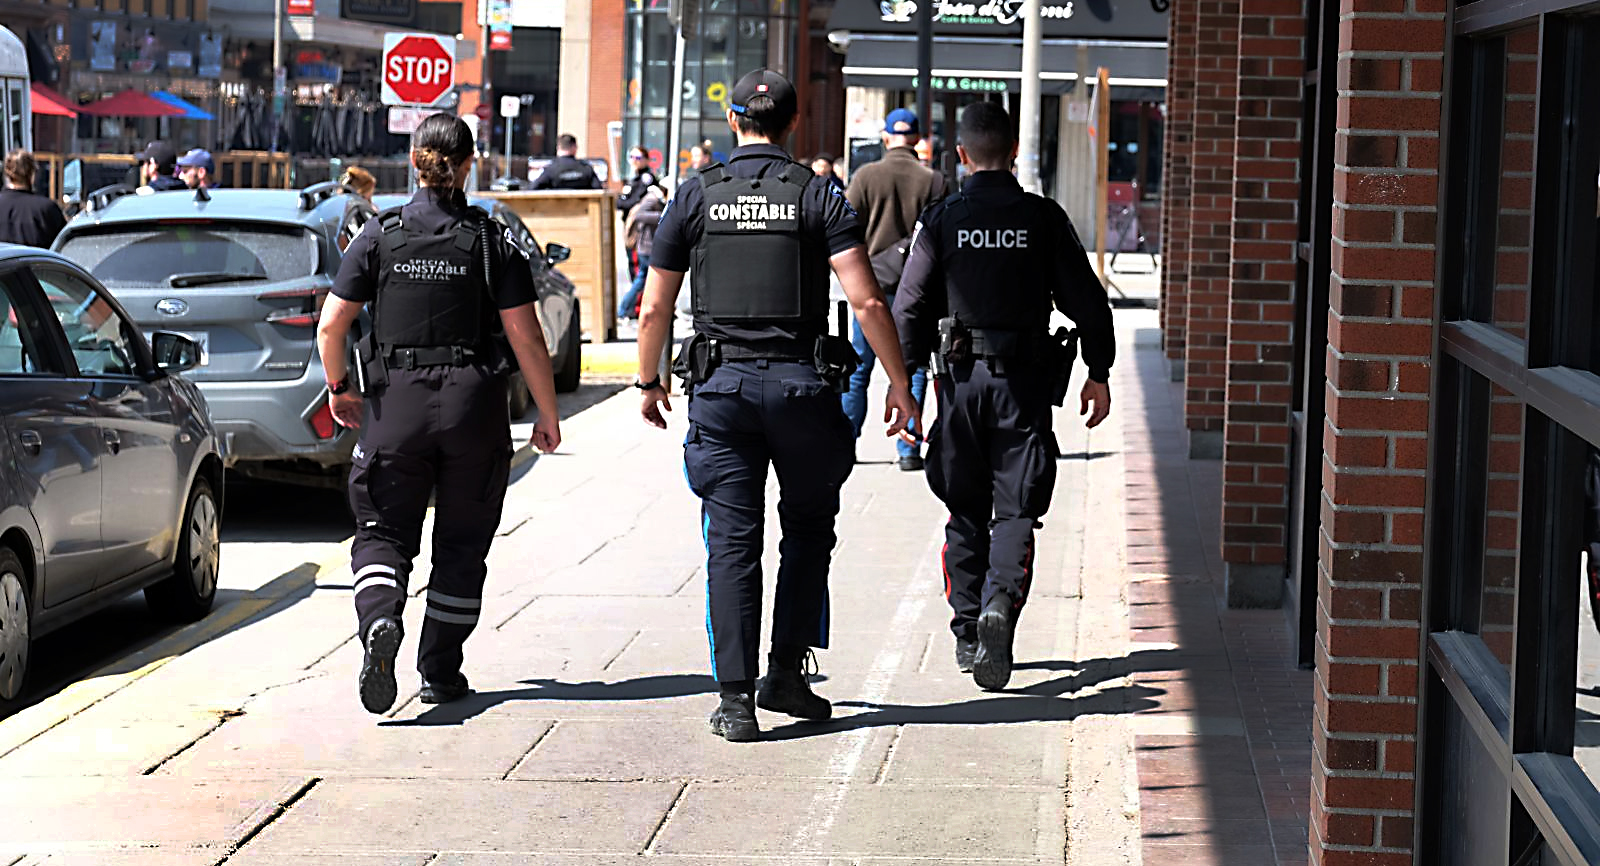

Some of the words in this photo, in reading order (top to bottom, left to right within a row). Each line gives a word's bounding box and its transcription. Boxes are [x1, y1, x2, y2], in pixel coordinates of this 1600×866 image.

[388, 55, 450, 85] STOP
[947, 78, 957, 89] &
[737, 195, 768, 204] SPECIAL
[709, 204, 796, 220] CONSTABLE
[957, 229, 1028, 248] POLICE
[393, 263, 467, 275] CONSTABLE
